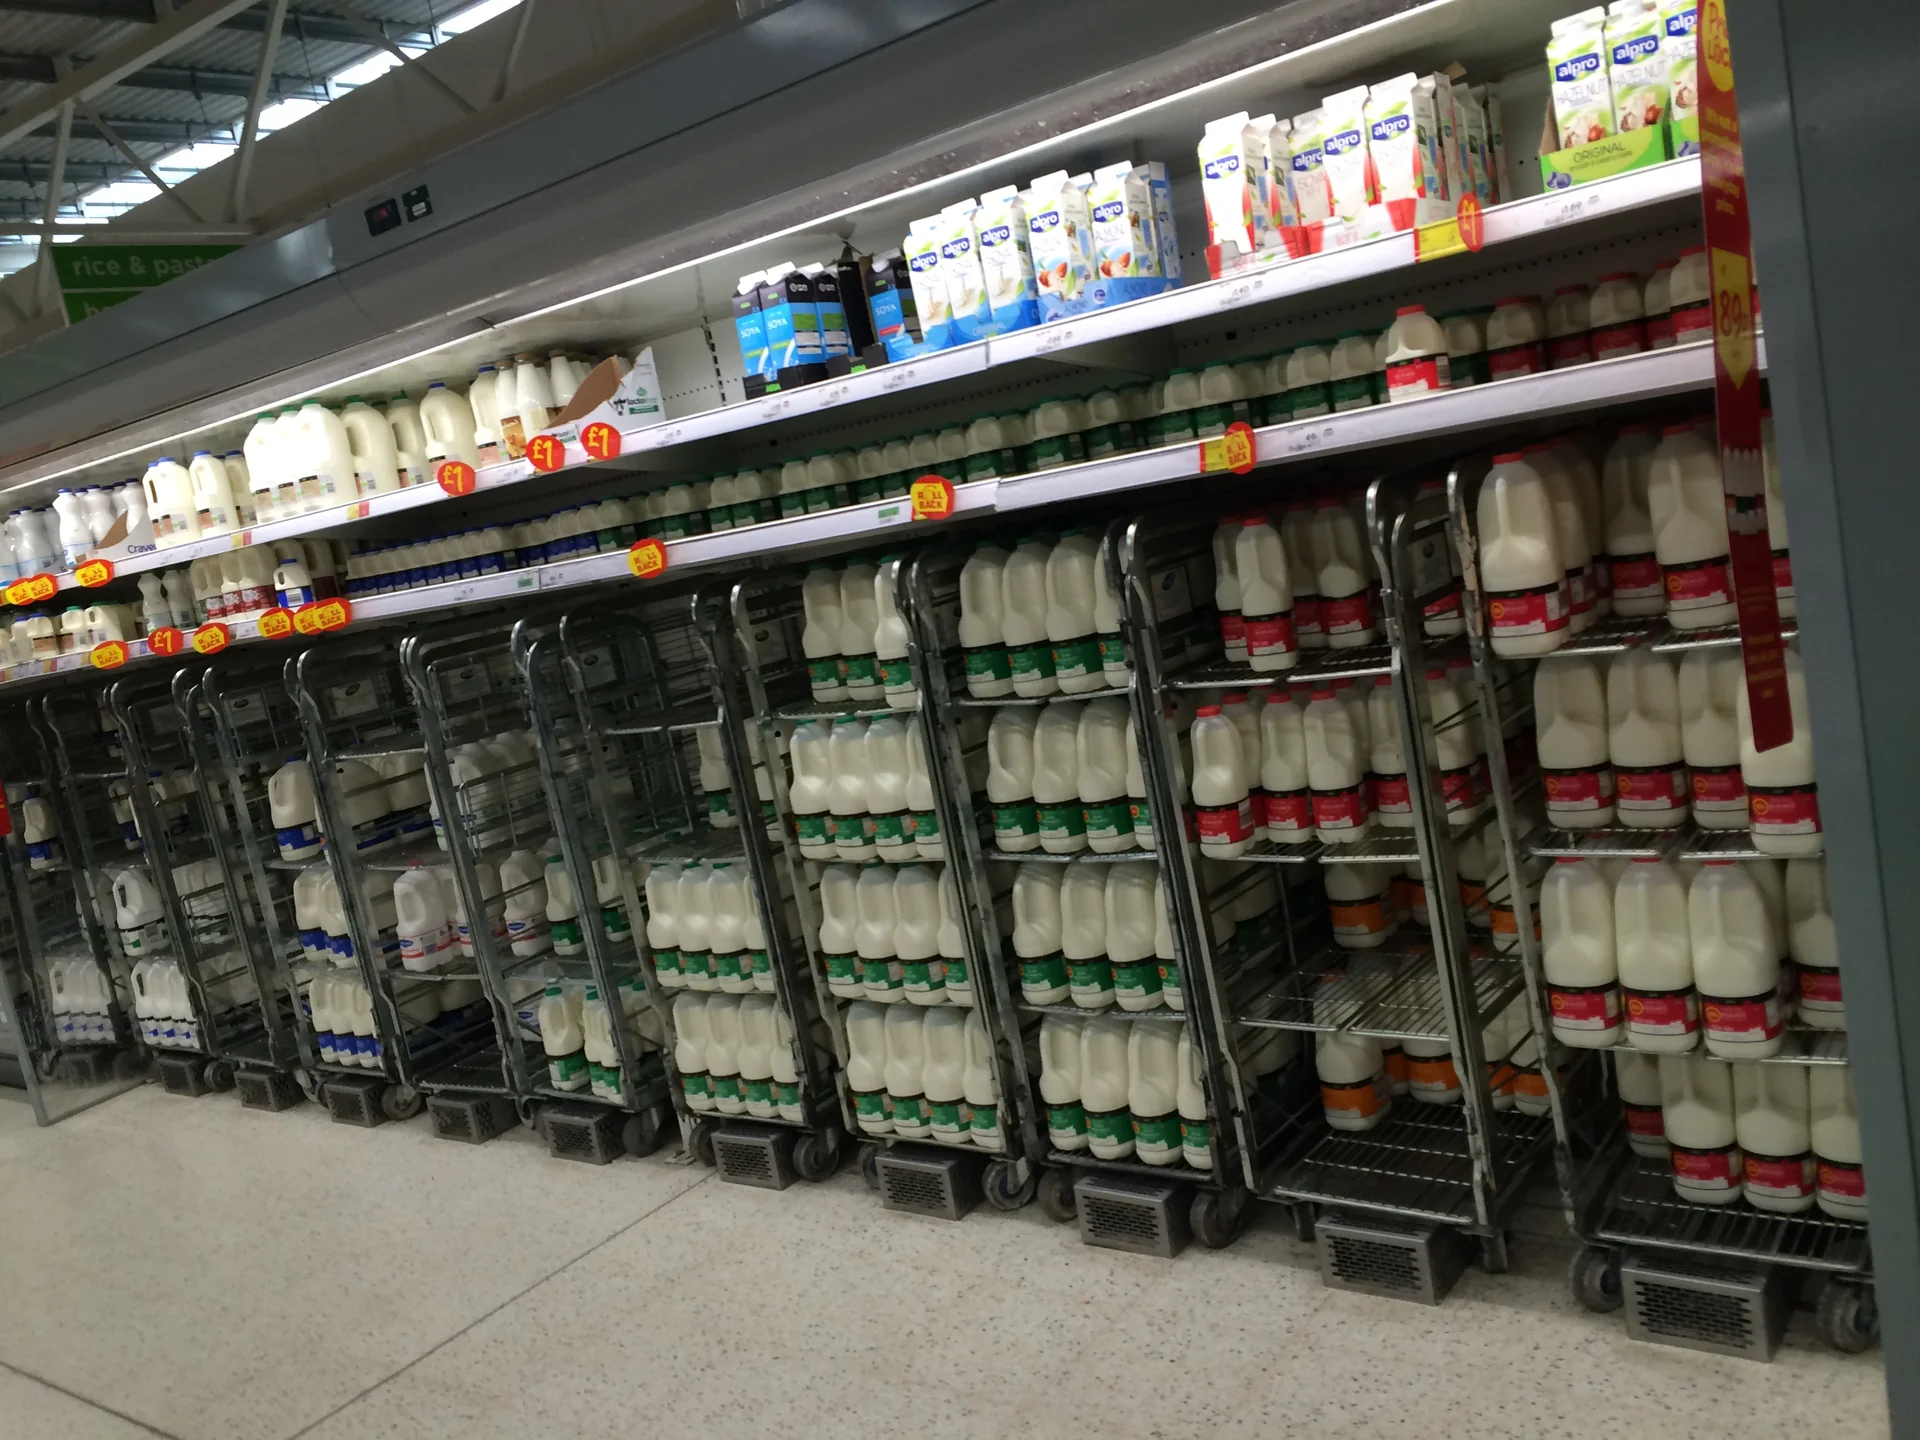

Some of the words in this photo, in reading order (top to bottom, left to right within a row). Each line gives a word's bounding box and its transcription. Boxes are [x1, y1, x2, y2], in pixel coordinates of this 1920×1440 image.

[1616, 39, 1656, 60] alpro
[1558, 57, 1597, 78] alpro
[1374, 118, 1408, 138] alpro
[1327, 133, 1359, 153] alpro
[1573, 140, 1626, 163] ORIGINAL
[1206, 157, 1238, 177] alpro
[1094, 203, 1122, 221] alpro
[1031, 212, 1059, 232] alpro
[981, 227, 1009, 246] alpro
[943, 239, 969, 258] alpro
[72, 255, 121, 276] rice
[129, 255, 147, 275] &
[153, 256, 212, 279] past
[911, 254, 937, 272] alpro
[875, 303, 897, 317] SOYA
[740, 326, 761, 339] SOYA
[767, 317, 788, 330] SOYA
[588, 426, 609, 457] £1
[532, 439, 553, 469] £1
[1229, 452, 1248, 466] BACK
[443, 466, 463, 492] £1
[918, 501, 943, 510] BACK
[127, 543, 157, 554] Crave
[637, 559, 659, 573] BACK
[266, 623, 287, 635] BACK
[321, 616, 342, 627] BACK
[154, 631, 172, 653] £1
